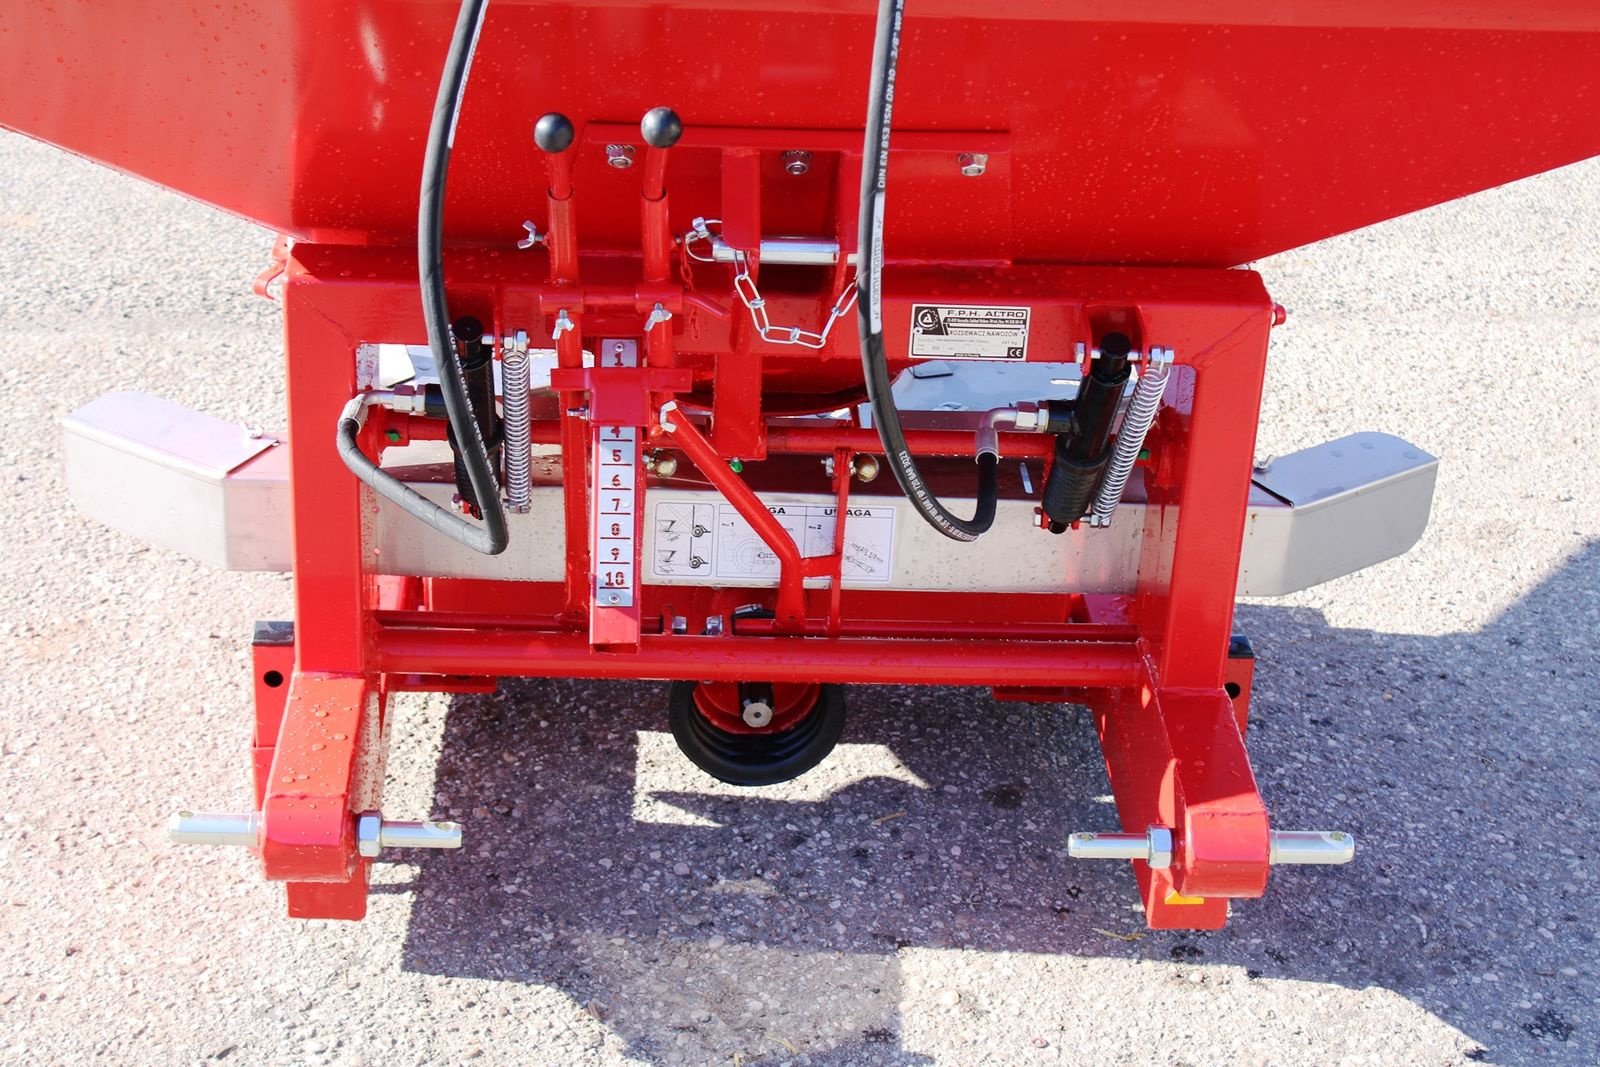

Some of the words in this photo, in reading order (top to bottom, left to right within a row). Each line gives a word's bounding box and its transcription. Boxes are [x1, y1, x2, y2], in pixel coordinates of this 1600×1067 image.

[887, 68, 896, 82] 10
[885, 84, 895, 102] DN
[883, 103, 893, 125] 1SN
[881, 127, 891, 149] 853
[879, 150, 889, 167] EN
[877, 168, 887, 189] DIN
[614, 352, 624, 367] 1
[612, 449, 622, 462] 5
[612, 474, 621, 487] 6
[611, 498, 620, 511] 7
[824, 508, 872, 517] UAGA
[611, 523, 620, 536] 8
[611, 548, 620, 560] 9
[605, 571, 624, 586] 10
